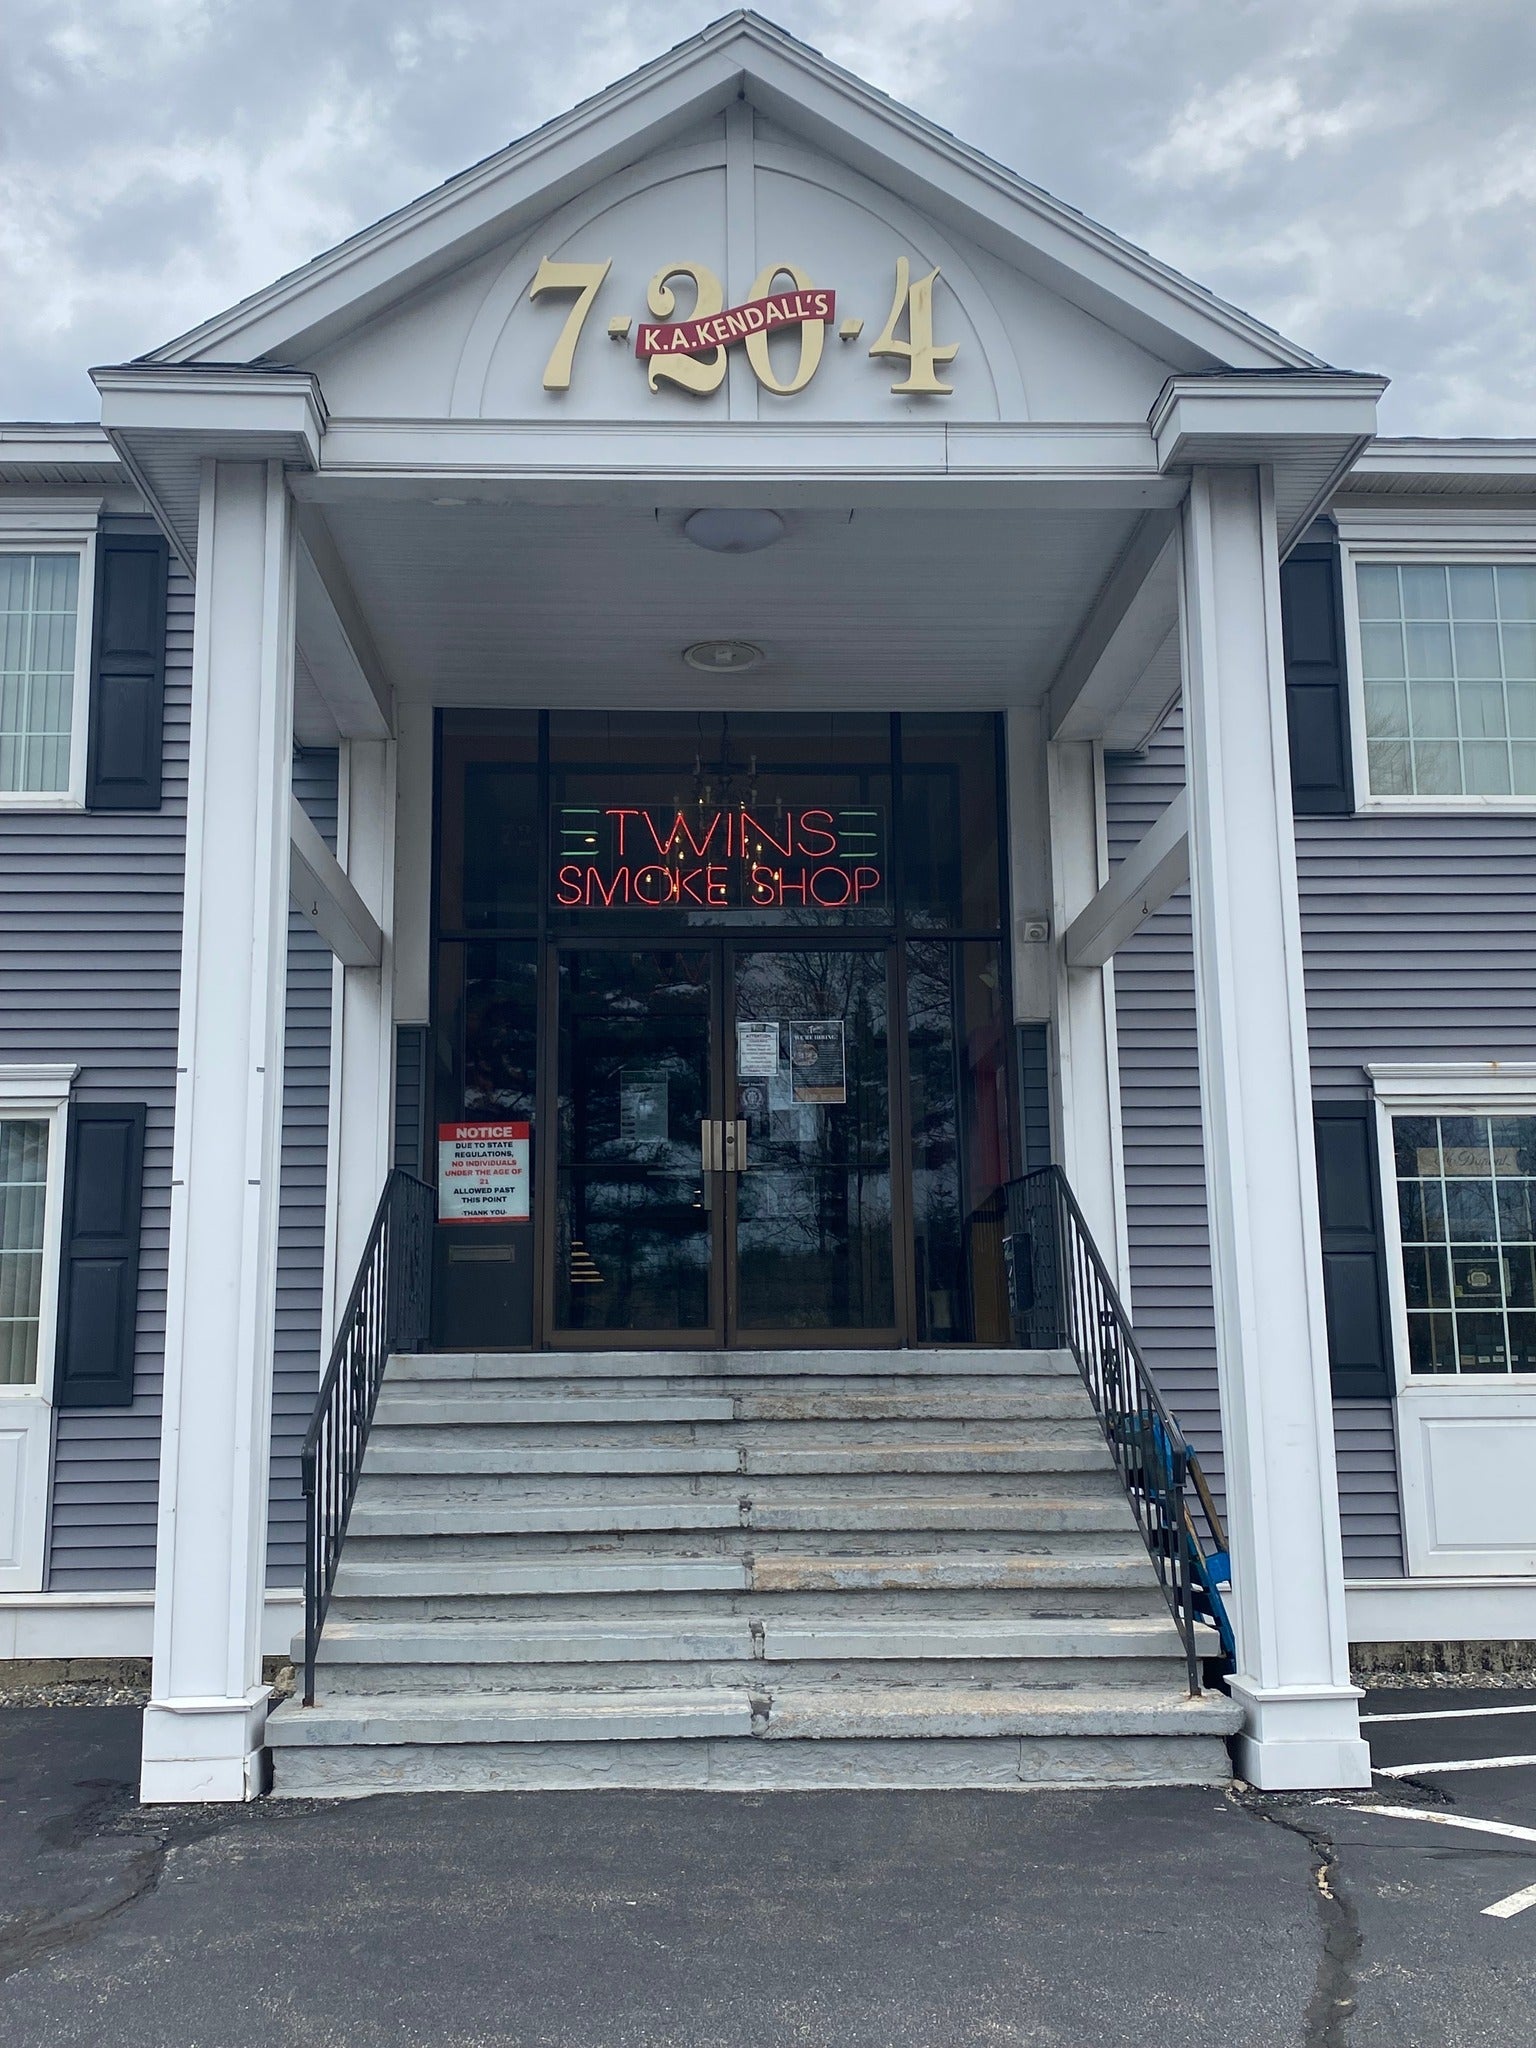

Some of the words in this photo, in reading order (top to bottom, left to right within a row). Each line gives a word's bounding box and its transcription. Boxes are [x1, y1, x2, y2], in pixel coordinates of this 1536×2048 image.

[605, 810, 836, 857] TWINS
[556, 865, 729, 906] SMOKE
[751, 866, 881, 908] SHOP
[456, 1127, 512, 1138] NOTICE
[1455, 1150, 1512, 1169] Dupnt
